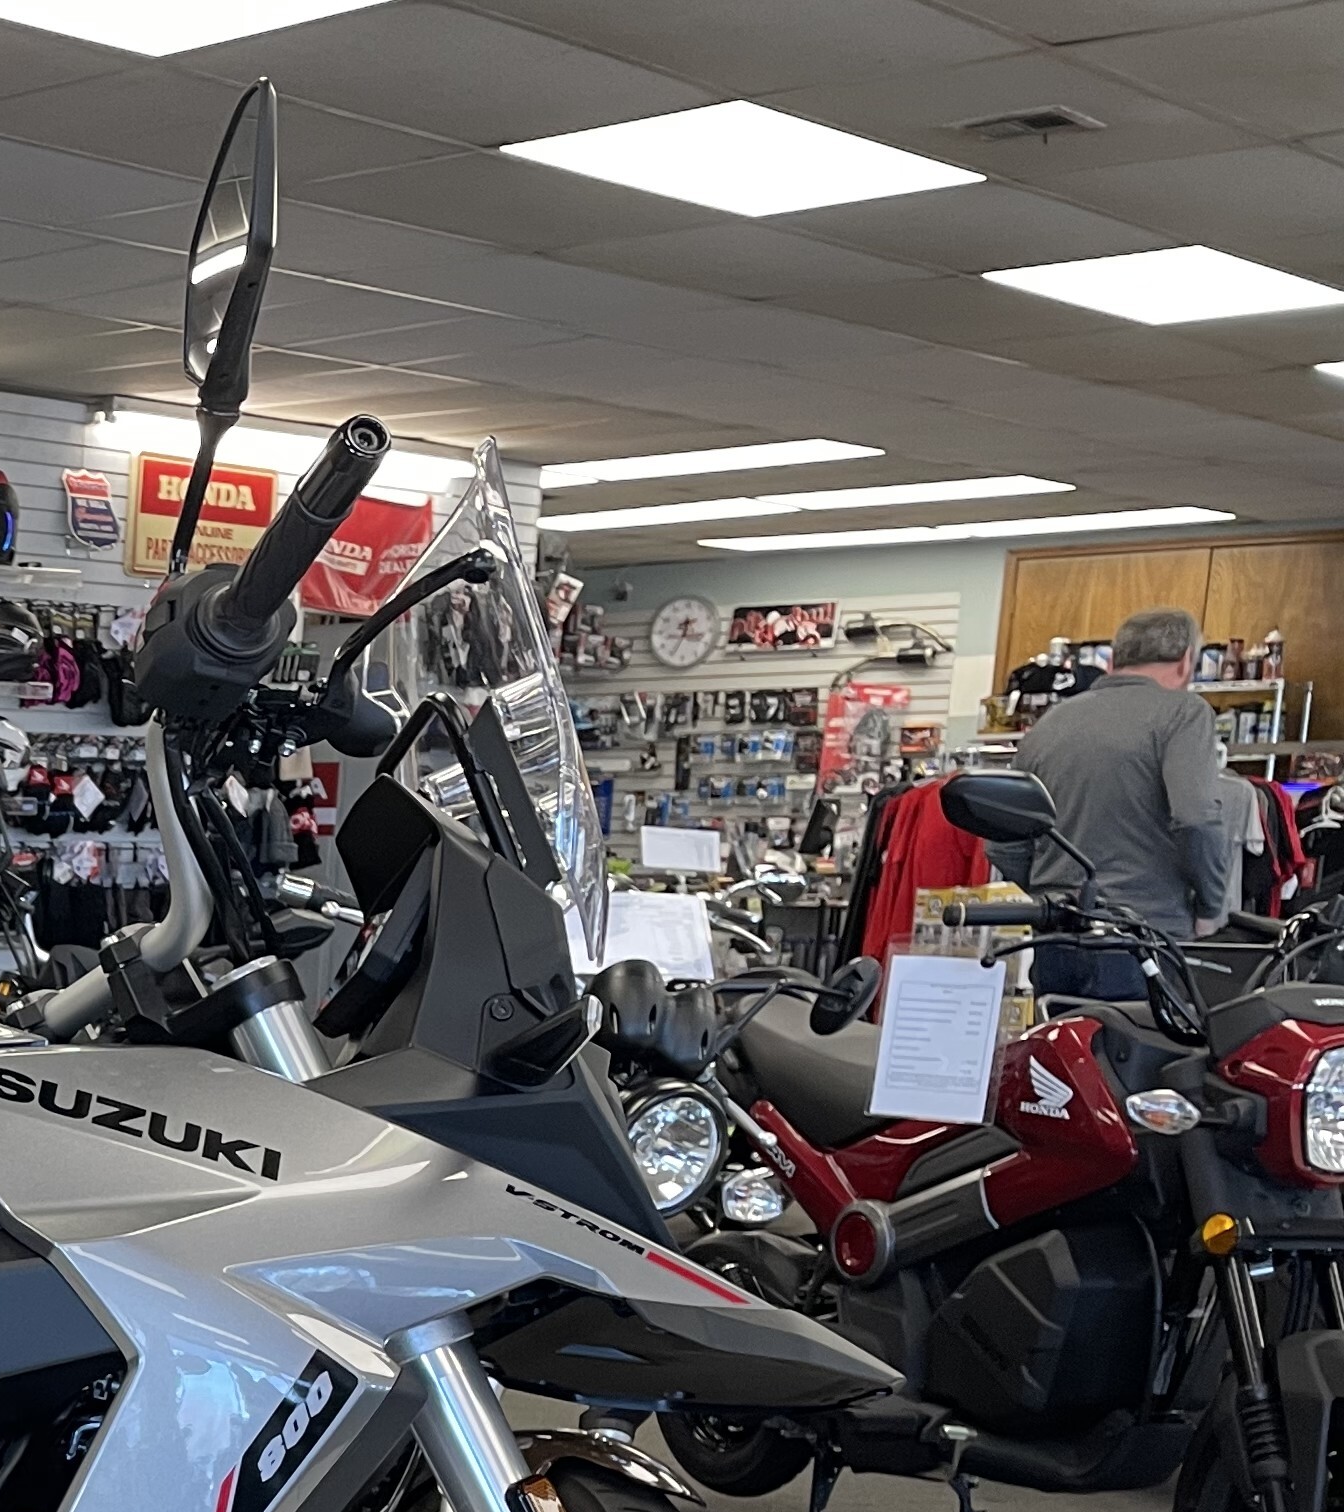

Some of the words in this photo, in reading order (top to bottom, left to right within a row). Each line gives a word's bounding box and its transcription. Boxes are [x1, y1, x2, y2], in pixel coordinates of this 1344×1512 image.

[196, 525, 234, 540] NUINE
[146, 536, 173, 560] PAR
[324, 537, 373, 561] NDA
[1019, 1101, 1071, 1120] HONDA
[505, 1184, 646, 1256] V-STROM
[258, 1370, 334, 1483] 800
